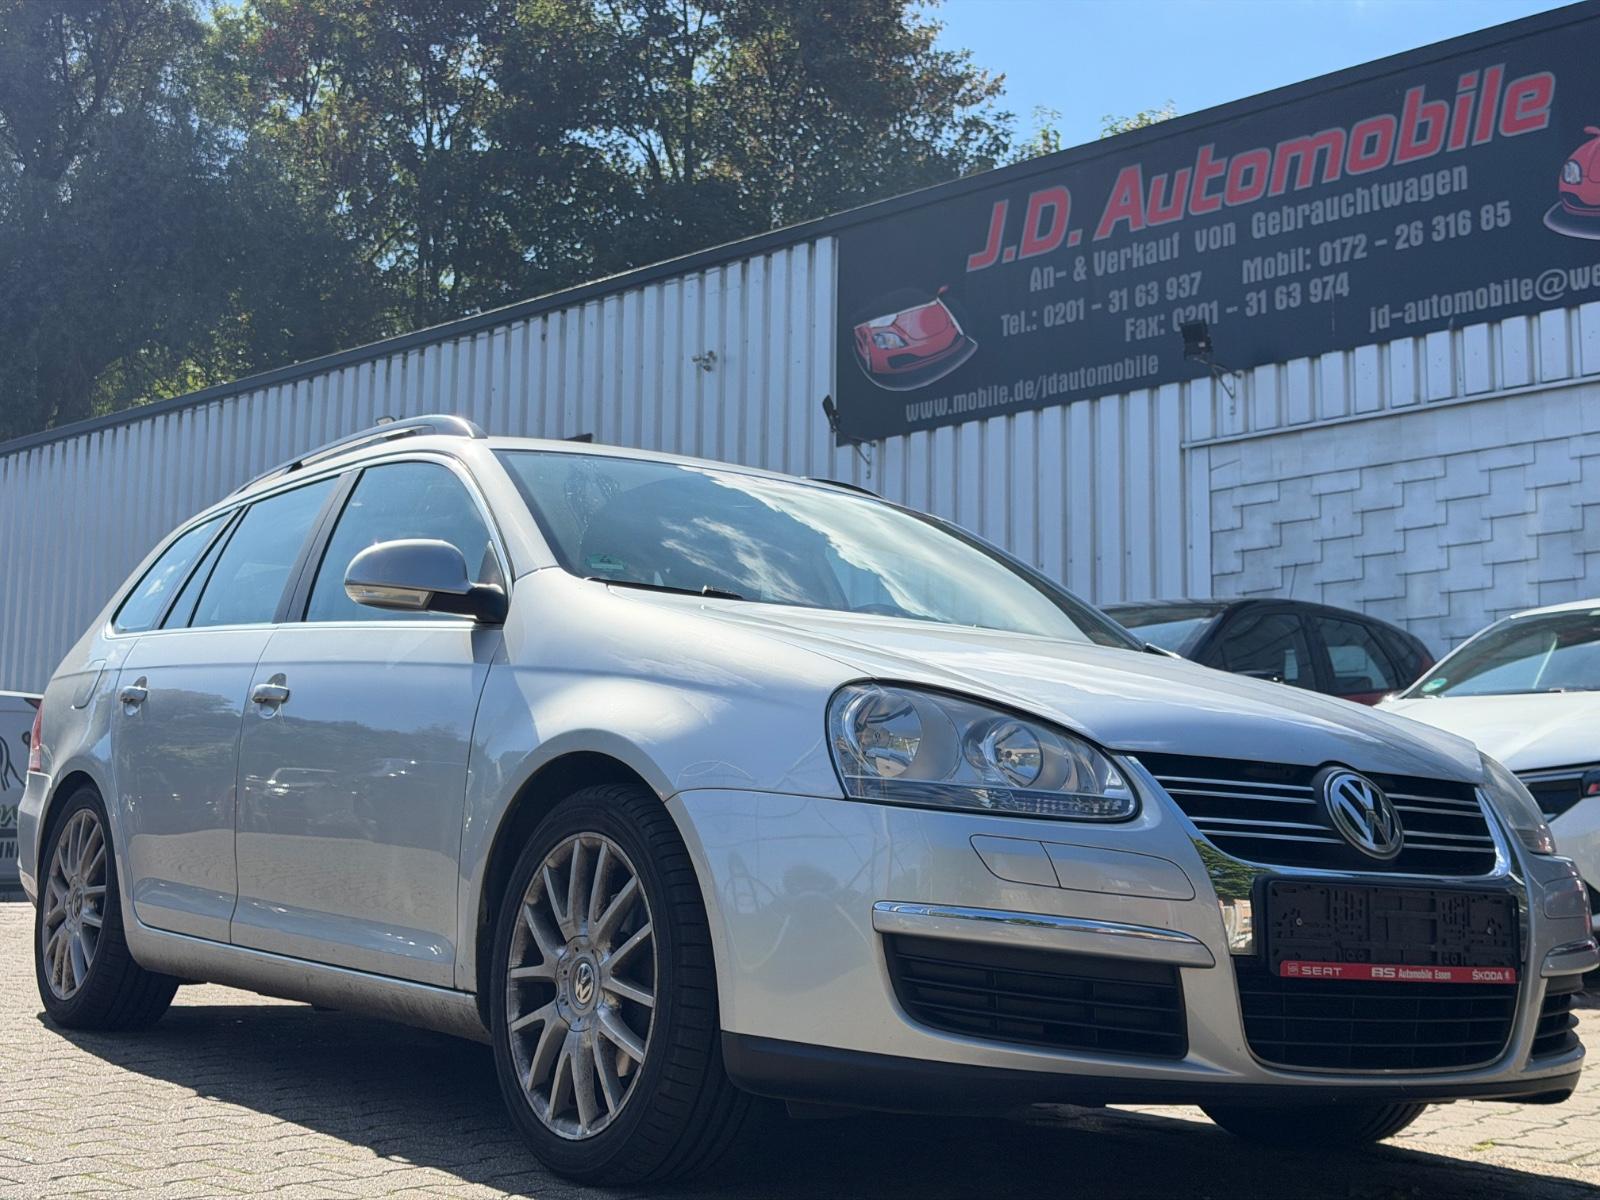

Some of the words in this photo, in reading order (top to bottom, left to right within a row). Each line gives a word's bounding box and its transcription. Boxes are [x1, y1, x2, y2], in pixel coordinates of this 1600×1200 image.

[966, 184, 1083, 272] J.D.
[1092, 63, 1556, 242] Automobile
[1030, 265, 1067, 292] An-
[1073, 256, 1087, 282] &
[1093, 232, 1181, 277] Verkauf
[1194, 221, 1237, 253] von
[1252, 165, 1468, 239] Gebrauchtwagen
[1241, 246, 1312, 285] Mobil:
[1318, 233, 1368, 267] 0172
[1394, 219, 1424, 251] 26
[1431, 209, 1472, 243] 316
[1479, 200, 1512, 232] 85
[1001, 310, 1038, 337] Tel.:
[1043, 297, 1085, 328] 0201
[1108, 287, 1128, 314] 31
[1134, 281, 1159, 308] 63
[1166, 270, 1202, 301] 937
[1125, 313, 1166, 342] Fax:
[1245, 289, 1268, 317] 31
[1274, 282, 1302, 311] 63
[1309, 271, 1350, 303] 974
[905, 354, 1159, 422] www.mobile.de/jdautomobile
[1301, 965, 1342, 976] SEAT
[1472, 969, 1504, 981] ŠKODA
